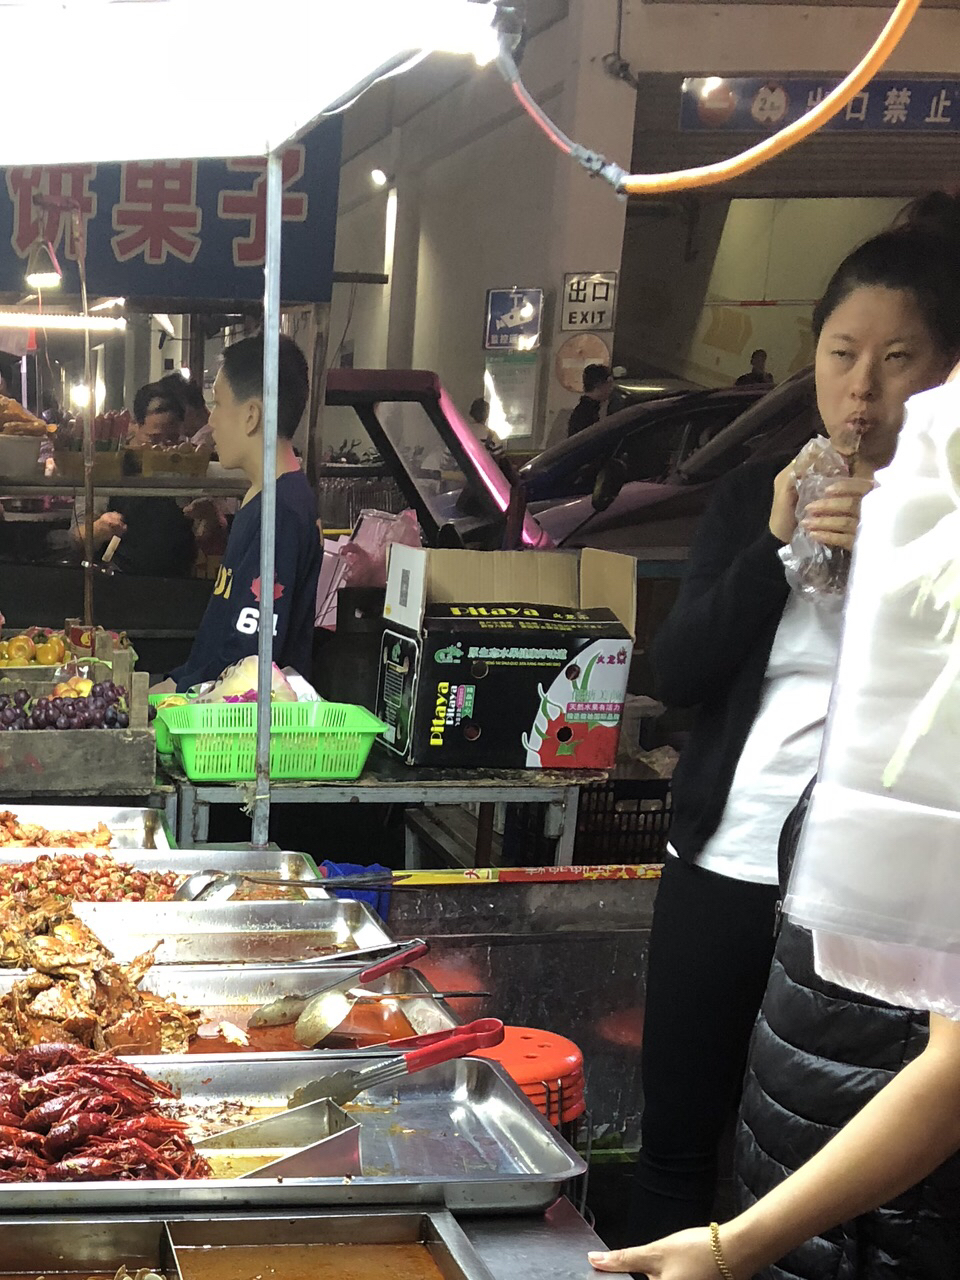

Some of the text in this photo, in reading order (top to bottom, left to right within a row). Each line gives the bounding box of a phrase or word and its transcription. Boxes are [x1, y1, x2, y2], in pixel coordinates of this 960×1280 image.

[568, 280, 609, 303] 出口
[568, 310, 606, 325] EXIT
[449, 606, 540, 617] Pitaya
[429, 681, 450, 746] Pitaya
[445, 685, 458, 726] Pitaya
